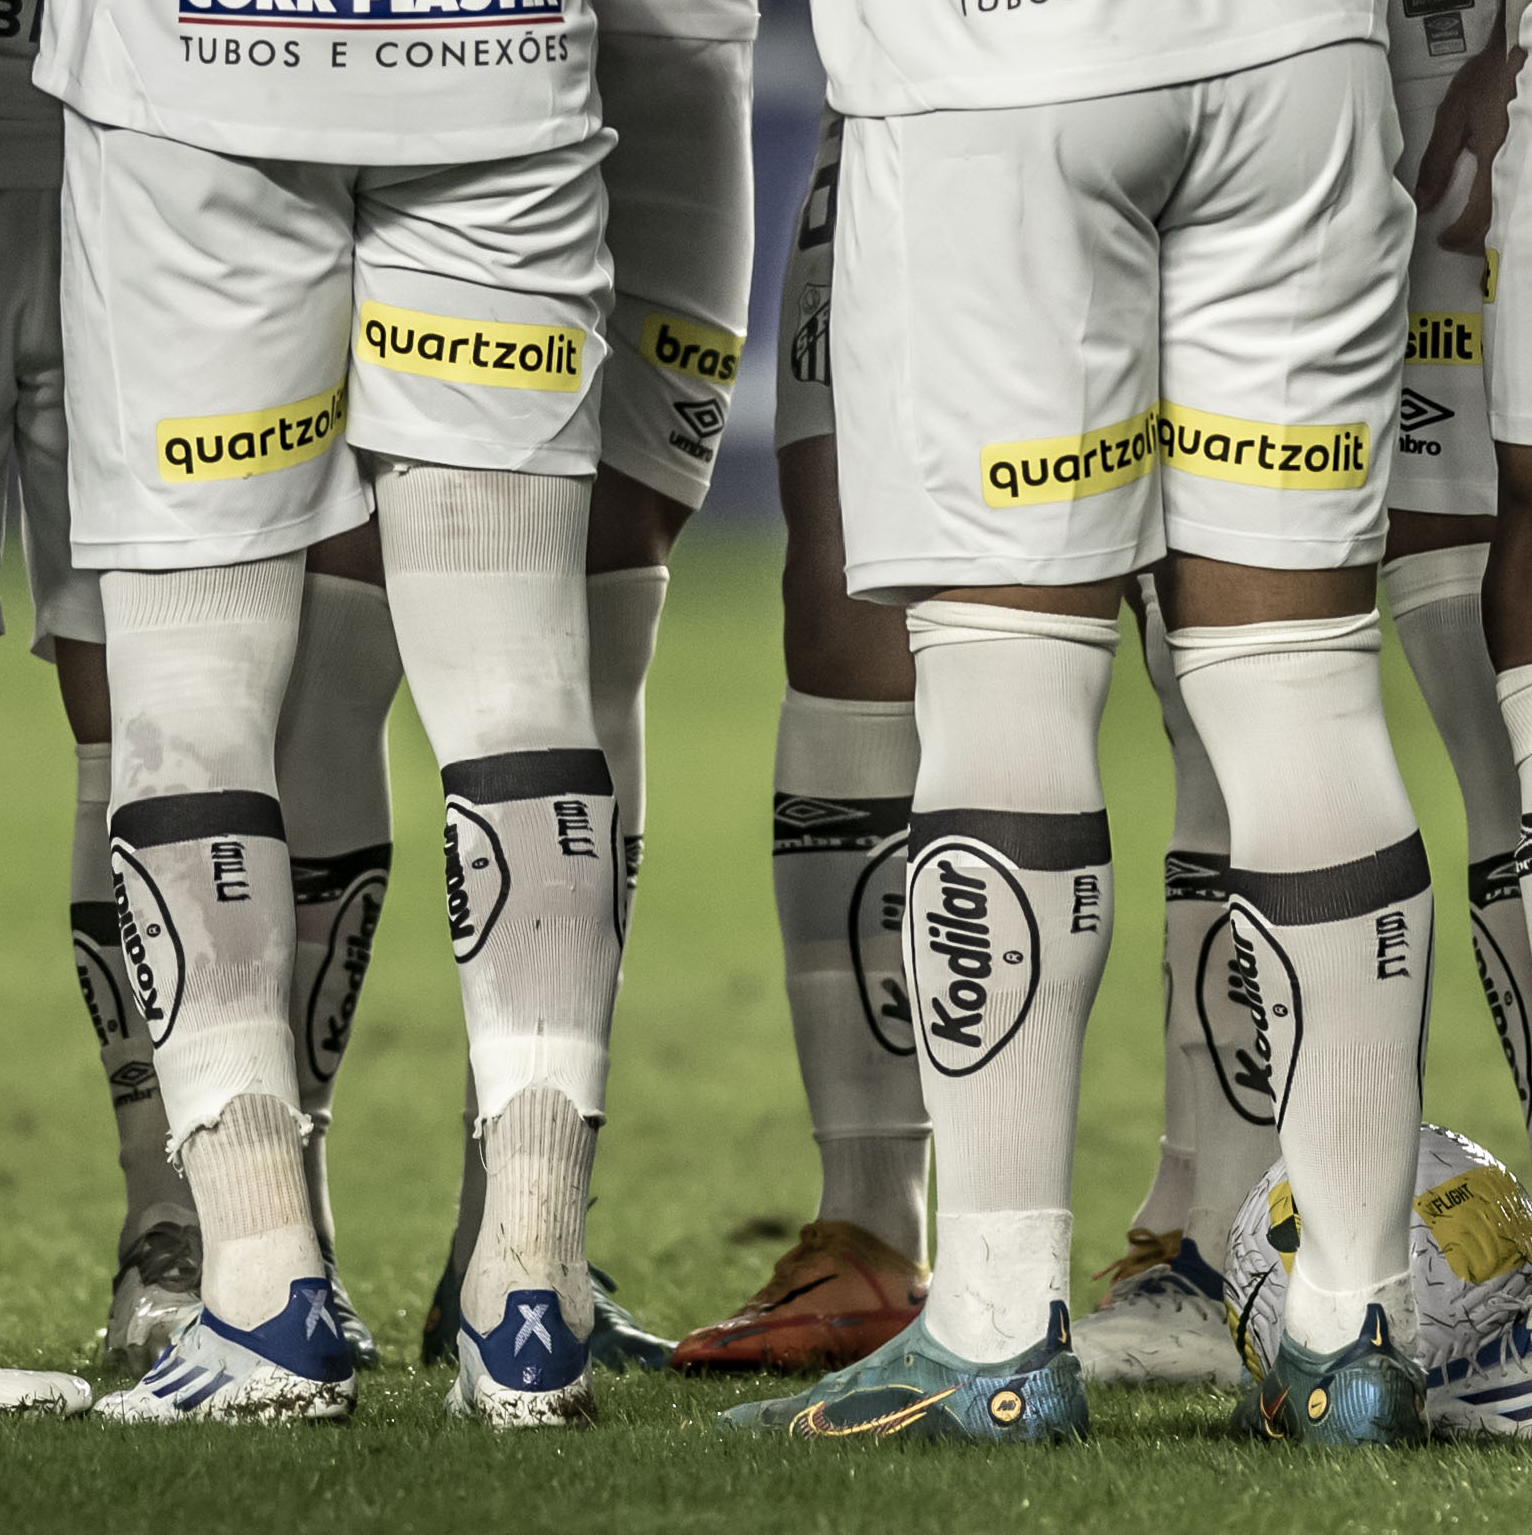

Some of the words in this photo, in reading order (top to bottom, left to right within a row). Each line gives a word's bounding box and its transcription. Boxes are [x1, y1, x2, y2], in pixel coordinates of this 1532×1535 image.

[180, 35, 300, 68] TUBOS
[332, 39, 348, 68] E
[374, 29, 569, 68] CONEXÕES
[366, 319, 578, 375] quartzolit
[1159, 416, 1365, 473] quartzolit
[926, 860, 993, 1048] Kodilar
[1432, 1182, 1475, 1215] FLIGHT
